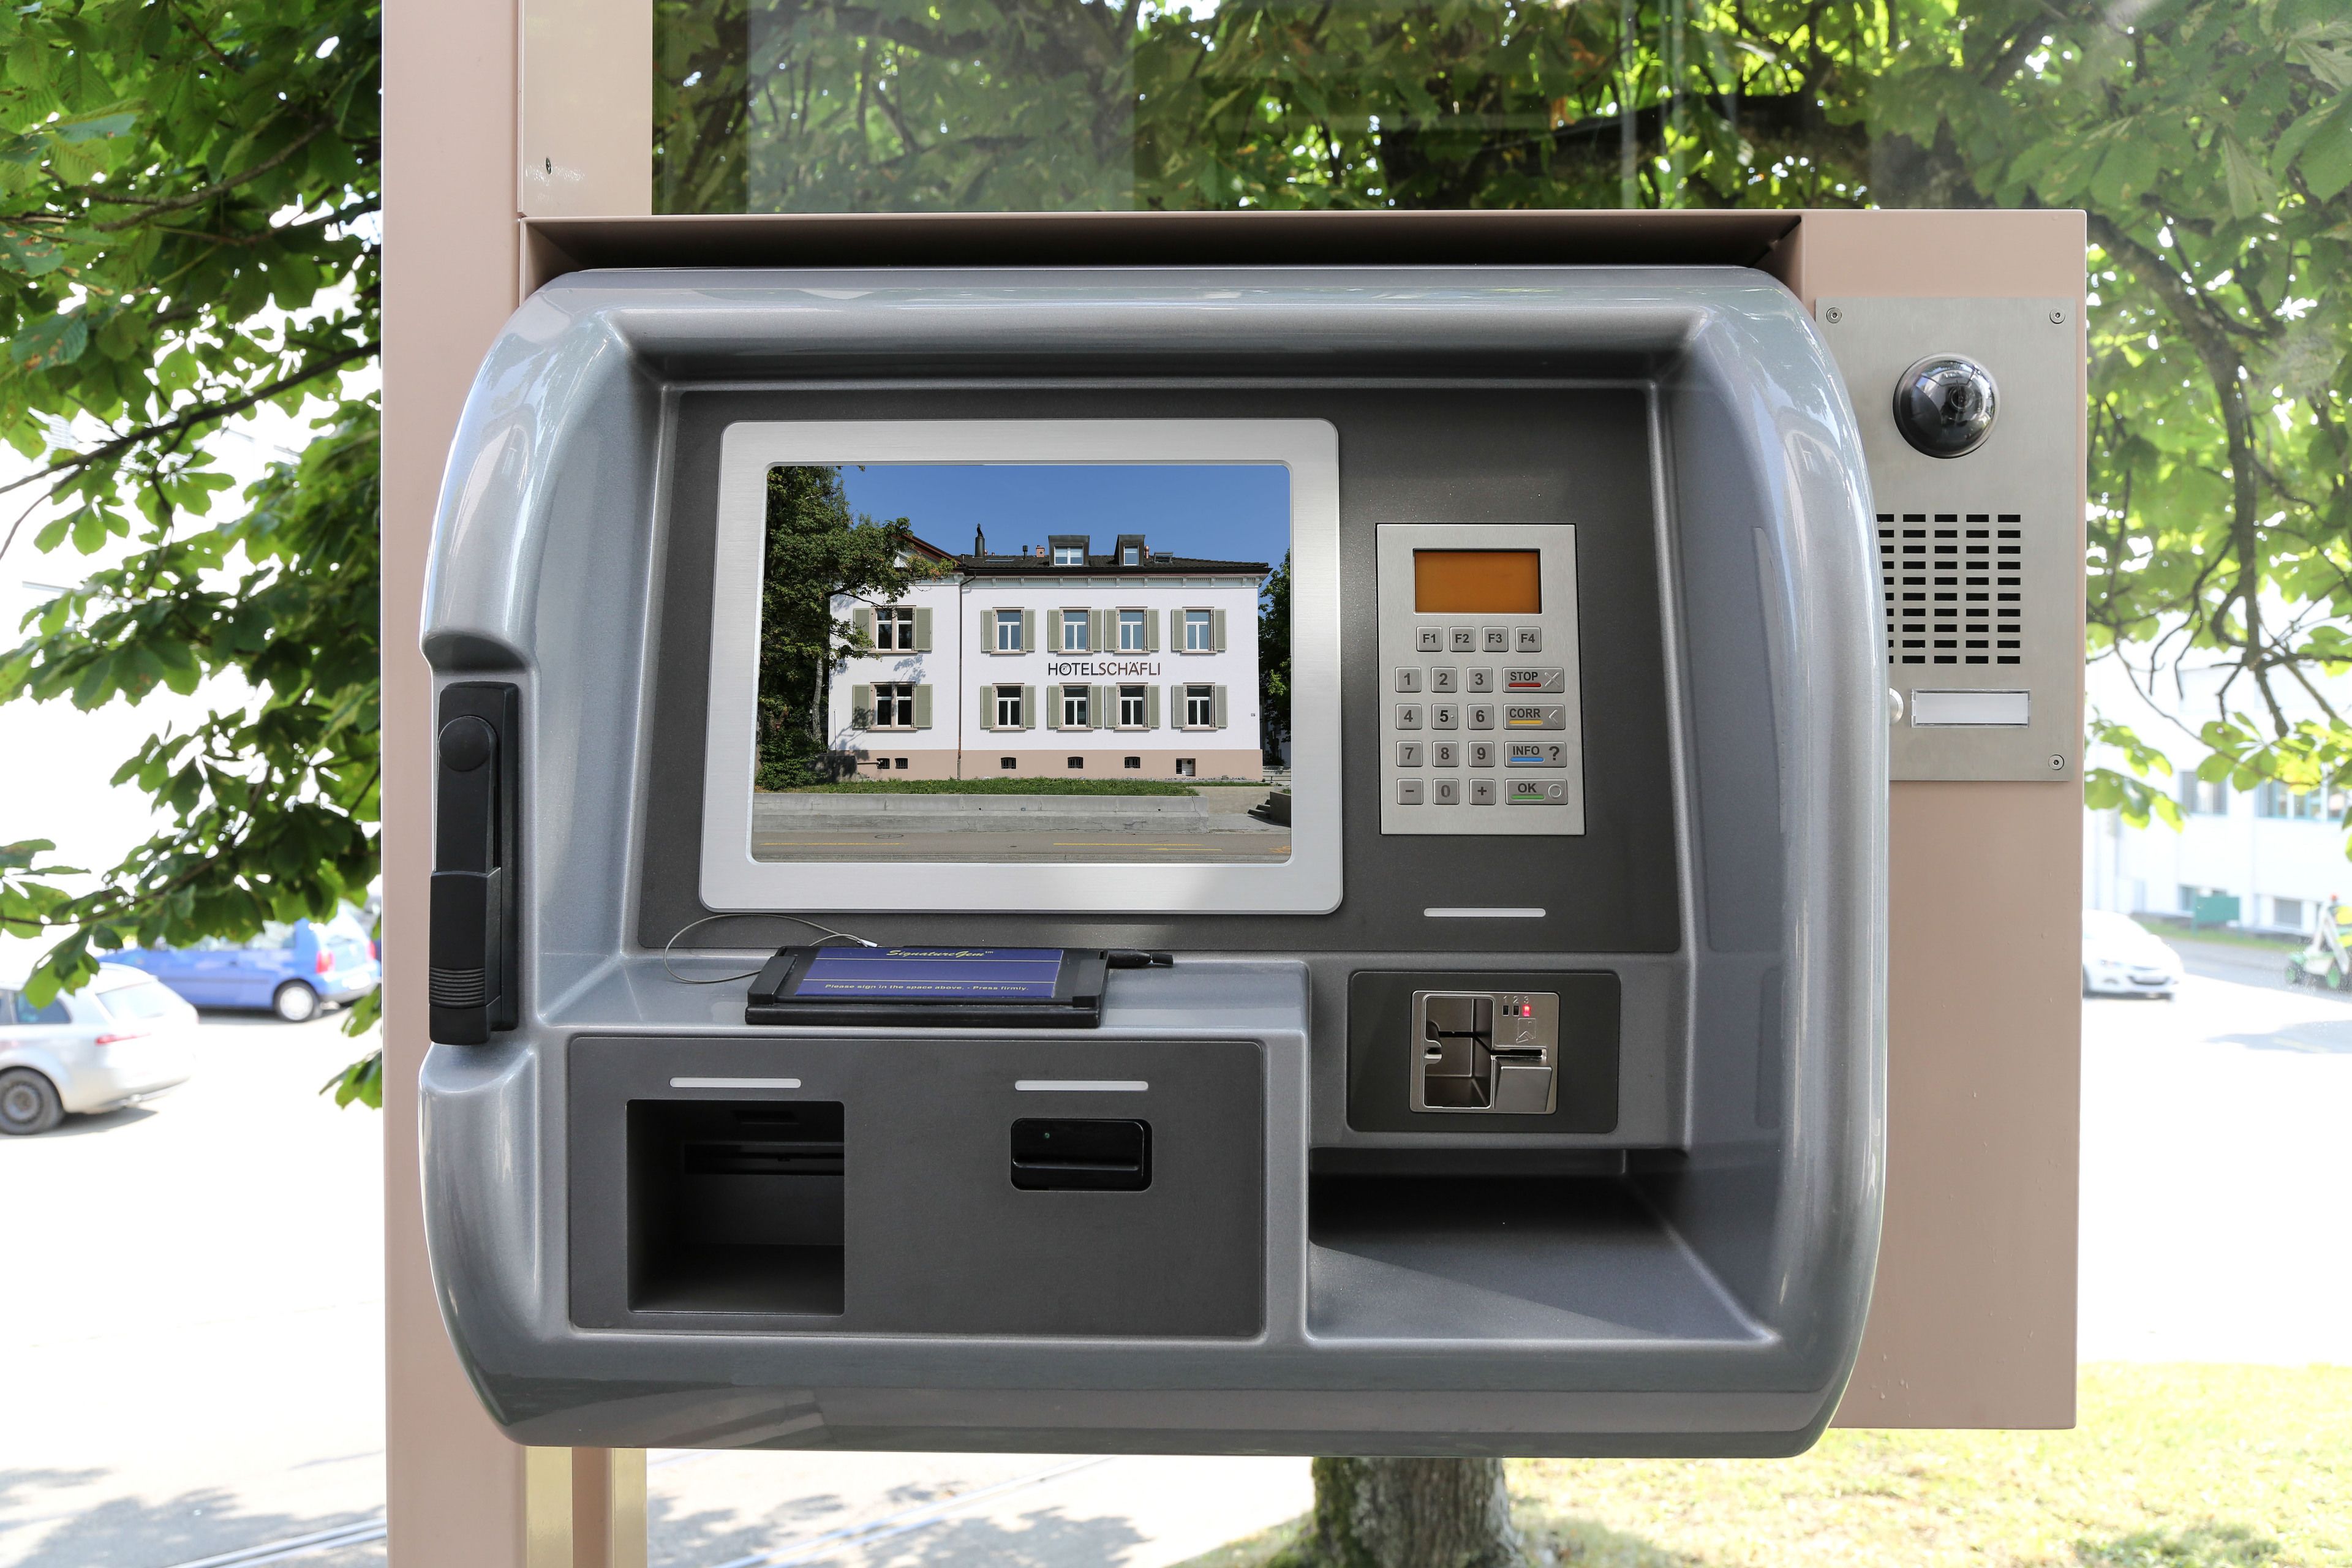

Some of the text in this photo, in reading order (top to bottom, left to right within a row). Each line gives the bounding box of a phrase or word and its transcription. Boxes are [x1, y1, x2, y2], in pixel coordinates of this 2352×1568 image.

[1423, 633, 1536, 643] F1 F2 F3 F4
[1404, 671, 1539, 685] 1 2 3 STOP
[1403, 708, 1541, 722] 4 5 6 CORR
[1404, 745, 1560, 761] 7 8 9 INFO ?
[1441, 785, 1450, 798] 0
[1517, 783, 1537, 793] OK
[1513, 995, 1519, 1004] 2
[1523, 995, 1529, 1004] 3
